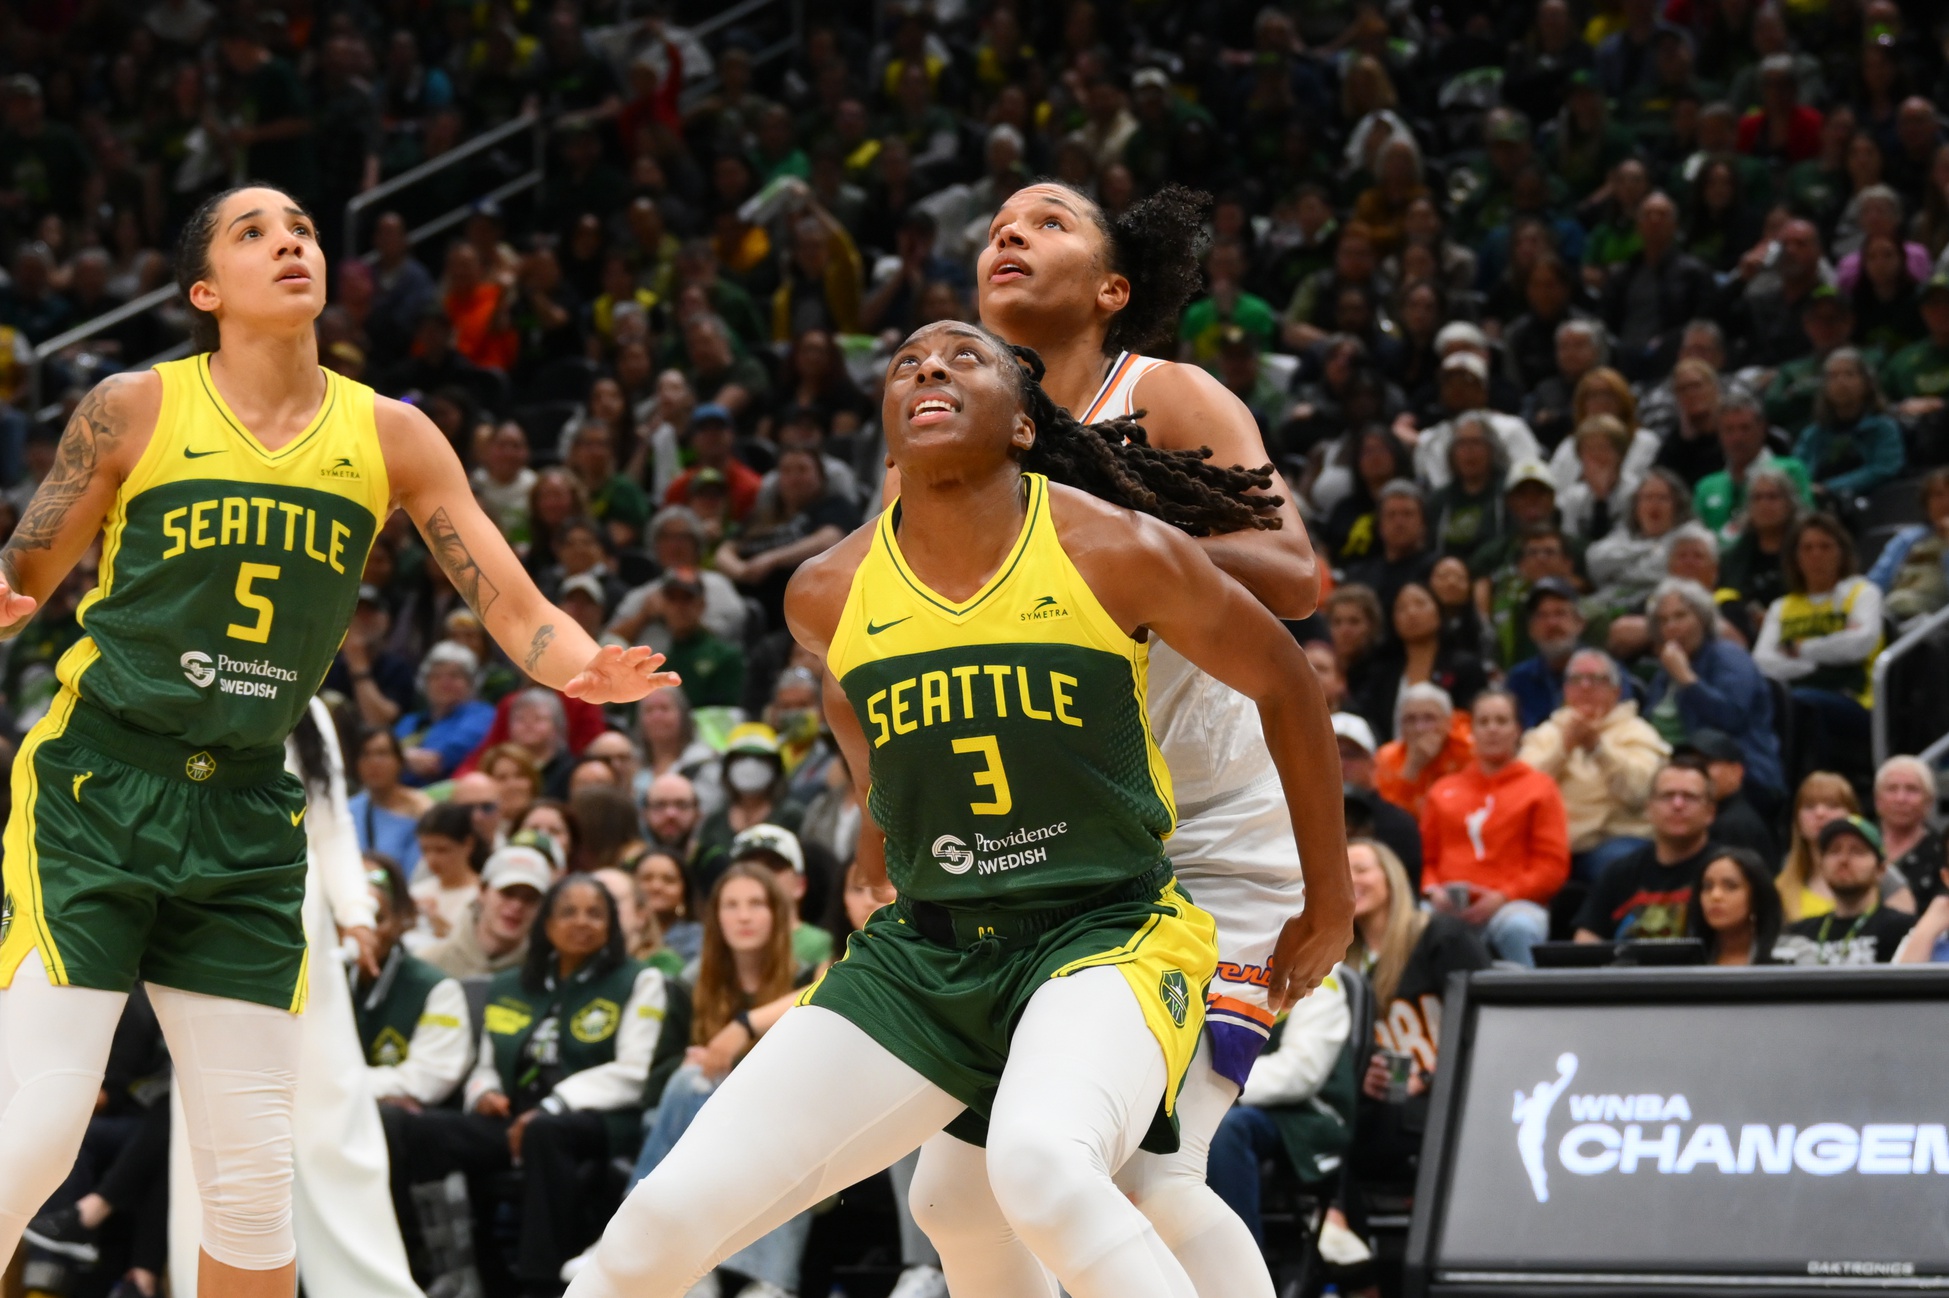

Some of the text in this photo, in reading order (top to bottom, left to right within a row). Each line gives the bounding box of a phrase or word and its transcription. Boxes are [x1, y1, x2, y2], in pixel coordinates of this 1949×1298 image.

[320, 469, 361, 479] SYMETRA
[162, 496, 351, 575] SEATTLE
[226, 561, 281, 644] 5
[1020, 608, 1069, 621] SYMETRA
[217, 653, 298, 682] Providenc
[219, 677, 278, 700] SWEDISH
[866, 664, 1083, 749] SEATTLE
[950, 734, 1013, 816] 3
[974, 821, 1068, 853] Providence
[977, 846, 1048, 876] SWEDISH
[1569, 1093, 1693, 1121] WNBA
